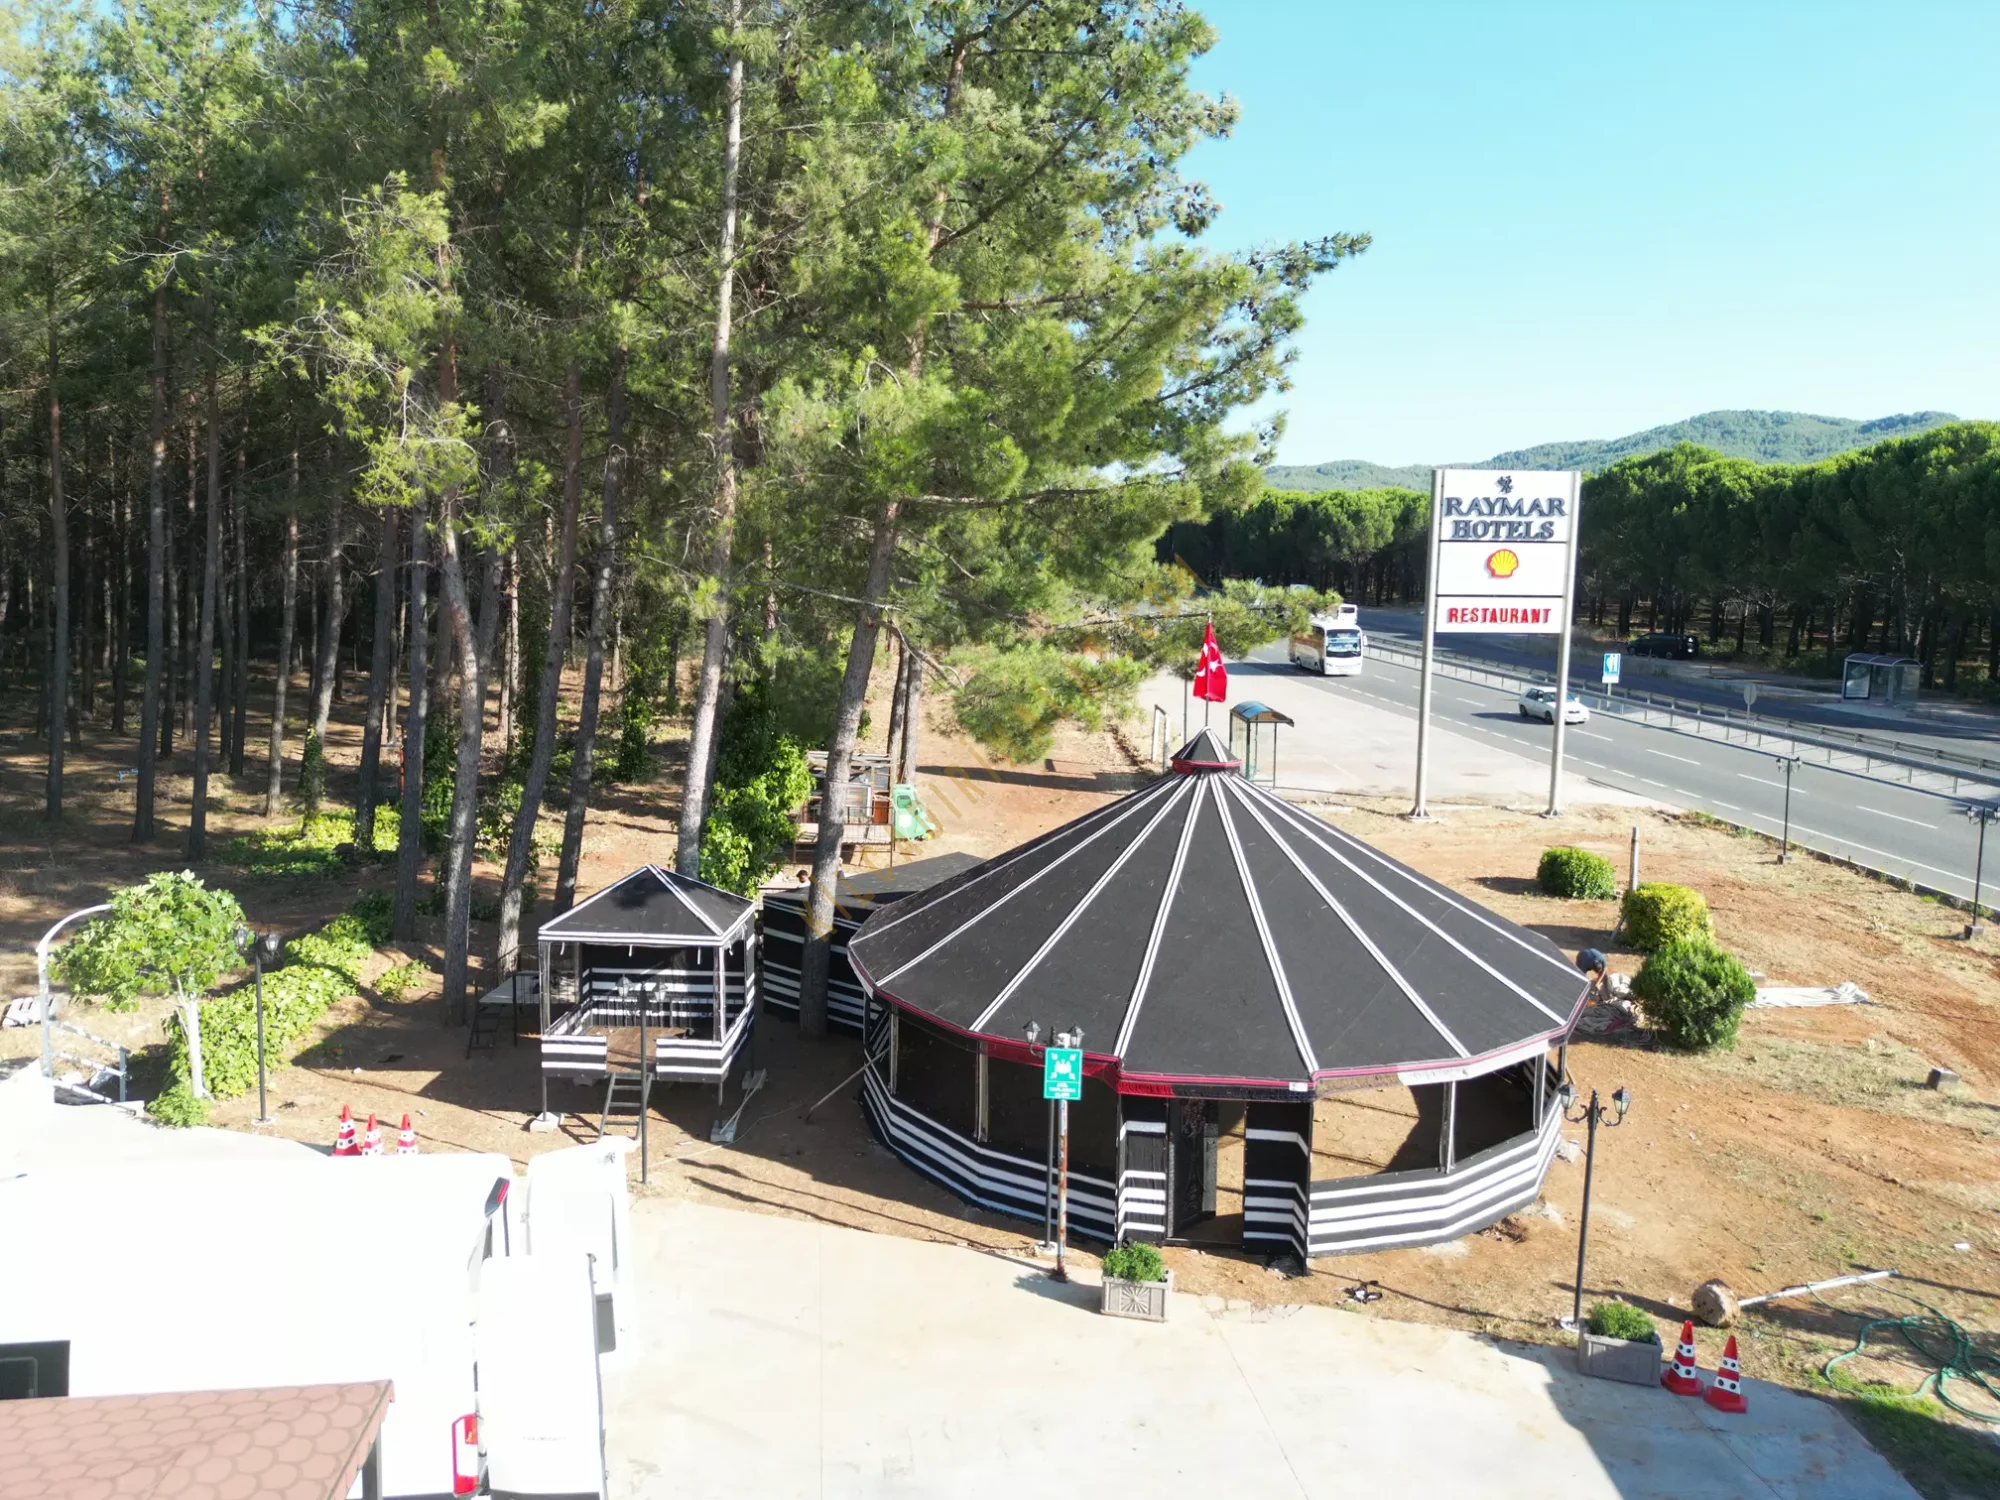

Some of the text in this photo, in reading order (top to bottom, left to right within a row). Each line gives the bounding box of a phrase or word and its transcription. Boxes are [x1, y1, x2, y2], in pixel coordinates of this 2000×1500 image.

[1445, 497, 1567, 517] RAYMAR
[1452, 520, 1554, 539] HOTELS
[1448, 608, 1551, 623] RESTAURANT
